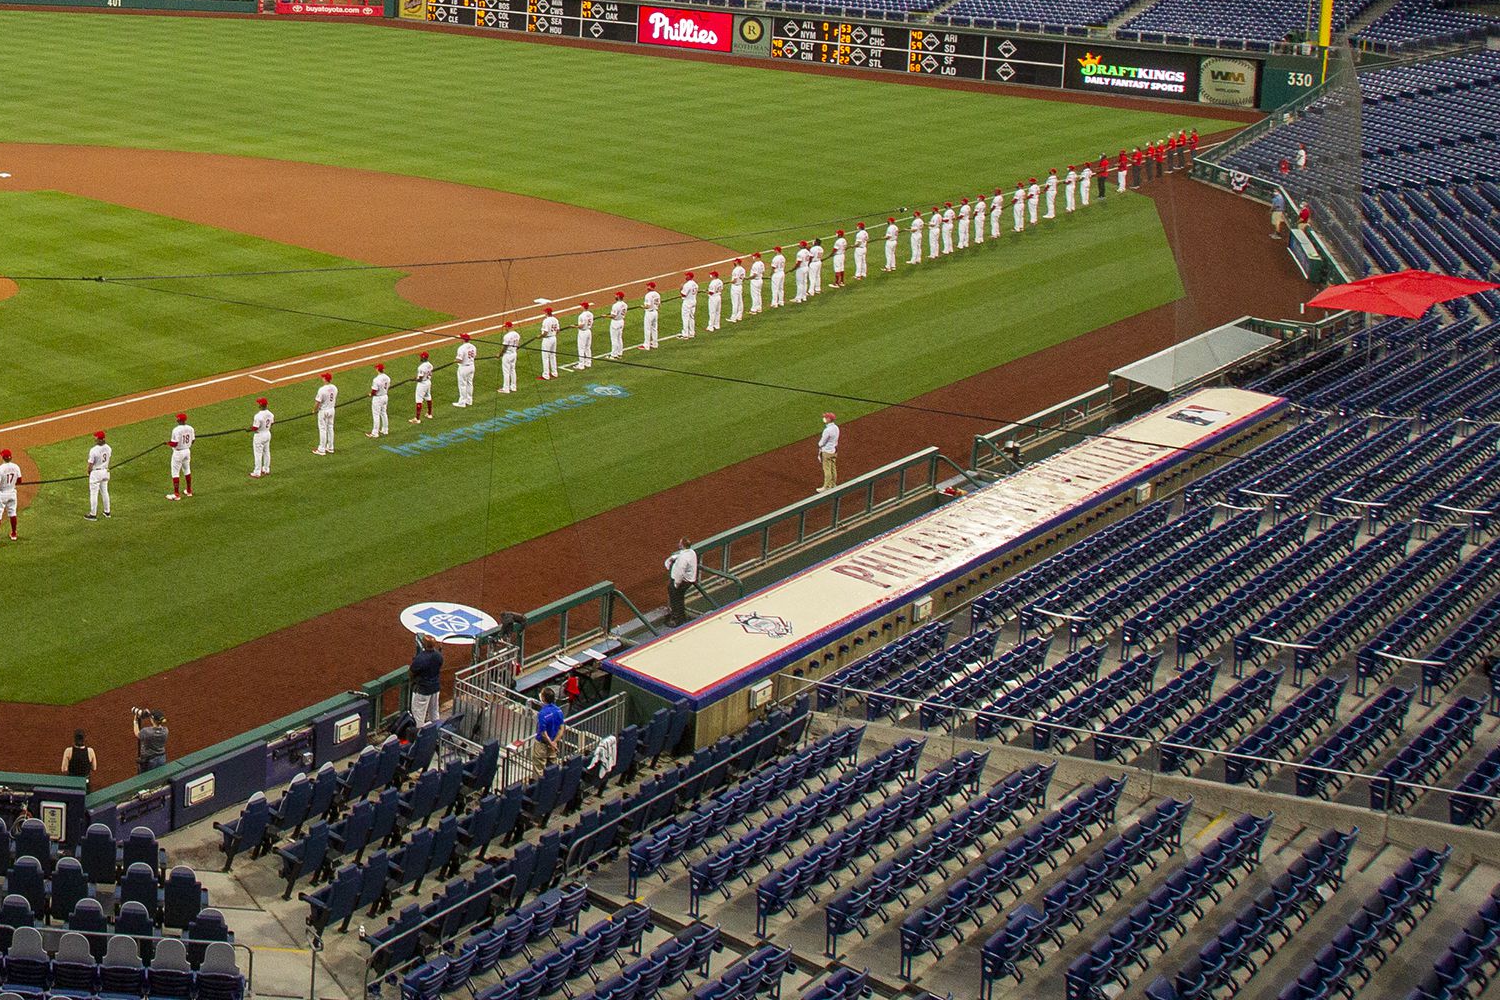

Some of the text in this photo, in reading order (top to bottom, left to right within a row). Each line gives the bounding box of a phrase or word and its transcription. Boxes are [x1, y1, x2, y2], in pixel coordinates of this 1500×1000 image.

[306, 5, 359, 13] buyatoyota.com
[550, 7, 563, 15] CWS
[498, 12, 509, 20] COL
[498, 21, 509, 29] TEX
[550, 26, 562, 34] HOU
[649, 12, 718, 45] Phillies
[802, 21, 828, 31] ATL 0
[841, 24, 884, 36] 53 MIL
[800, 31, 816, 39] NYM
[911, 31, 958, 43] 40 ARI
[801, 42, 814, 51] DET
[822, 44, 827, 52] 0
[869, 38, 885, 46] CHC
[911, 42, 956, 53] 59 SD
[772, 49, 782, 57] 54
[801, 51, 813, 60] CIN
[840, 46, 882, 57] 59 PIT
[840, 56, 882, 68] 22 STL
[911, 53, 954, 65] 31 SF
[909, 63, 956, 76] 68 LAD
[1081, 63, 1186, 83] DRAFTKINGS
[1211, 69, 1247, 83] WM
[1287, 72, 1313, 87] 330
[1084, 75, 1185, 93] DAILY FANTASY SPORTS
[182, 435, 190, 444] 18
[6, 473, 14, 484] 17
